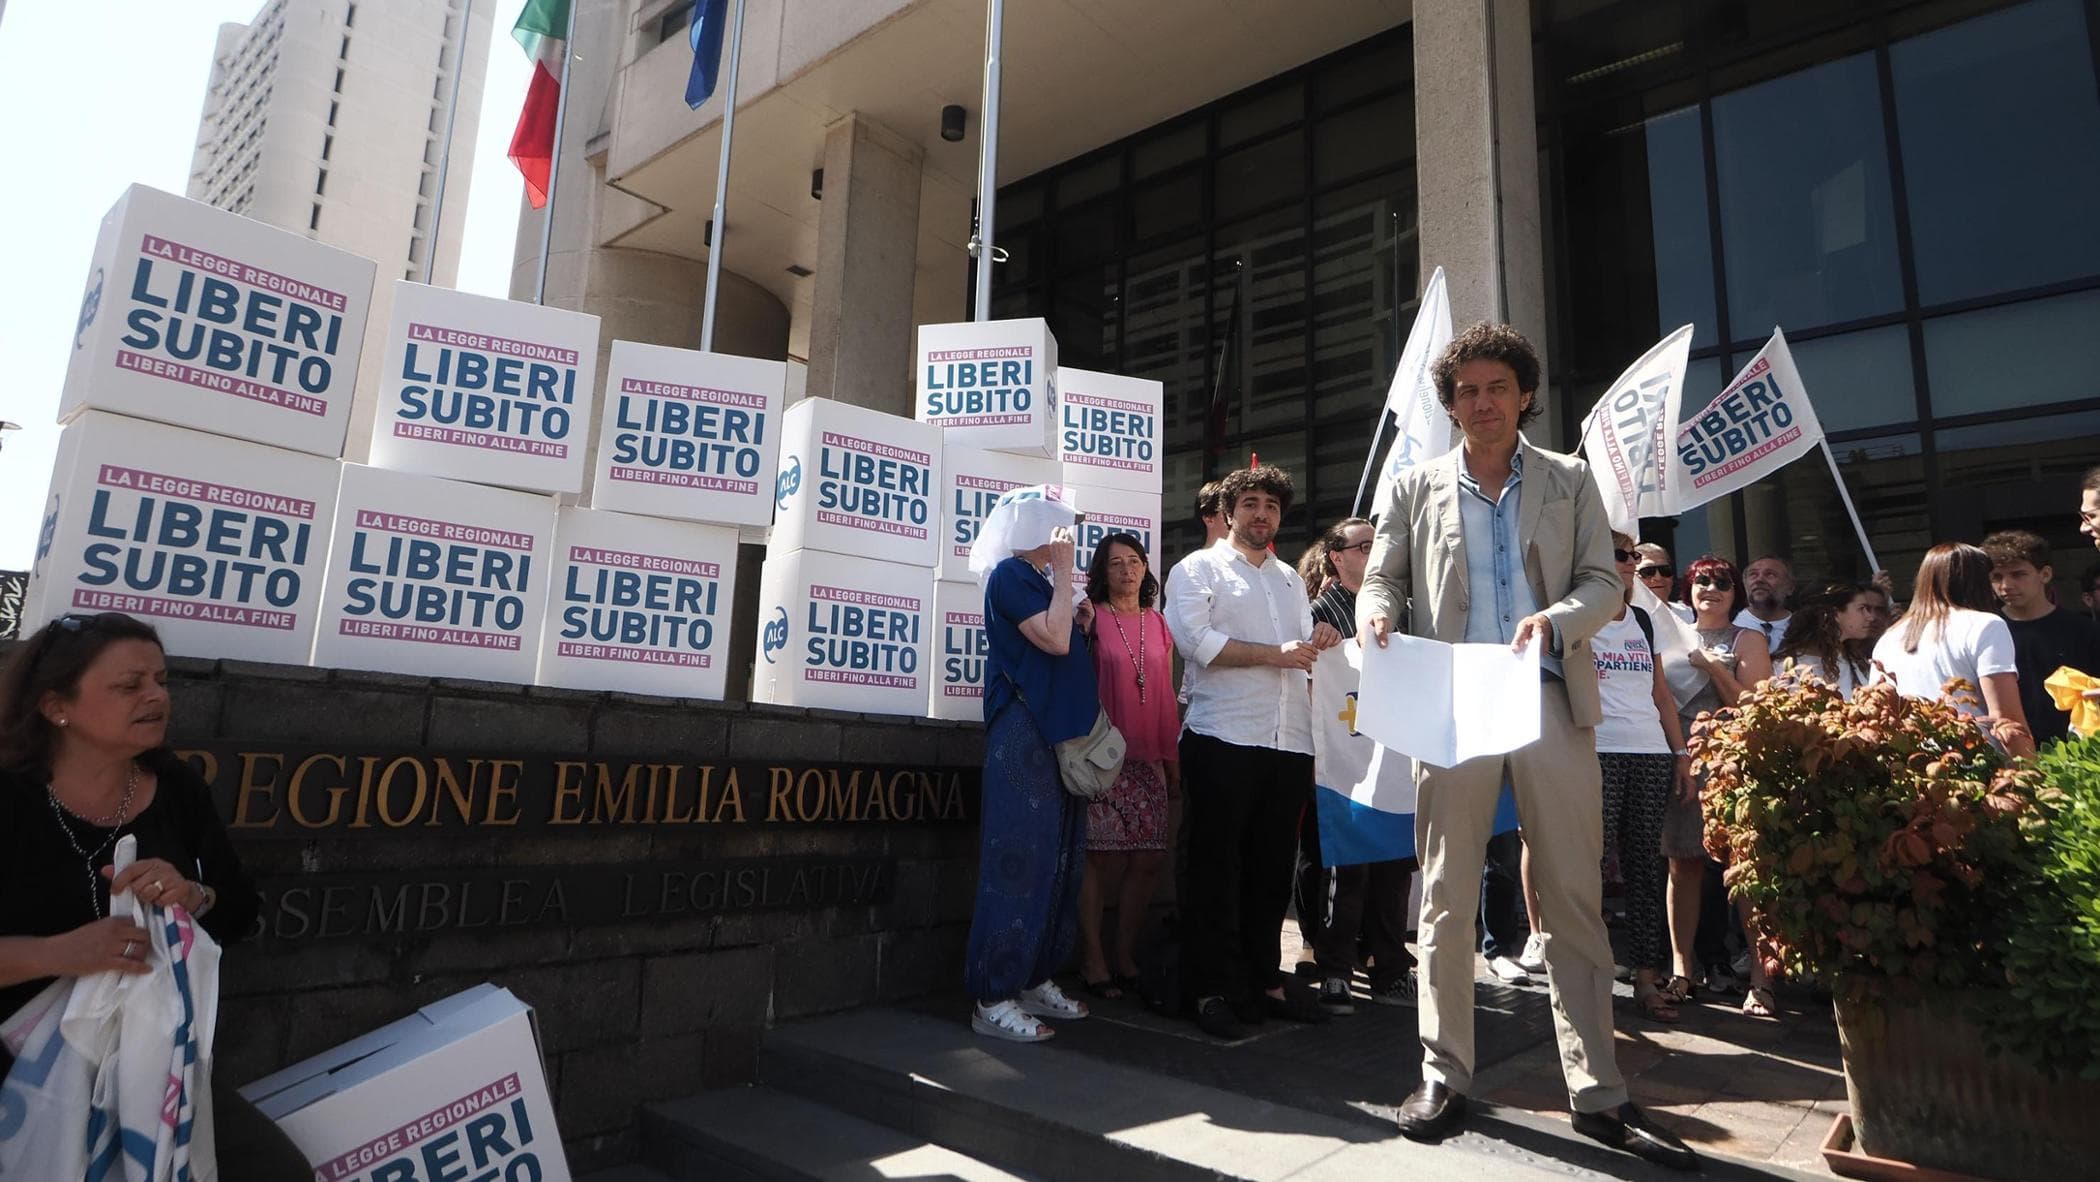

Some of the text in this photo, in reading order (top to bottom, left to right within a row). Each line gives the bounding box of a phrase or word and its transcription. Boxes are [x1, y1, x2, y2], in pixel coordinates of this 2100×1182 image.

[148, 238, 344, 309] LA LEGGE REGIONALE
[131, 256, 342, 355] LIBERI
[121, 311, 330, 392] SUBITO
[413, 326, 576, 363] LA LEGGE REGIONALE
[931, 348, 1030, 361] LA LEGGE REGIONALE
[121, 353, 322, 413] LIBERI FINO ALLA FINE
[402, 342, 576, 404] LIBERI
[928, 360, 1031, 389] LIBERI
[626, 380, 764, 407] LA LEGGE REGIONALE
[927, 388, 1030, 415] SUBITO
[1067, 394, 1151, 412] LA LEGGE REGIONALE
[396, 386, 569, 439] SUBITO
[617, 395, 764, 445] LIBERI
[960, 417, 981, 425] FINO
[983, 416, 1006, 424] ALLA
[1008, 415, 1029, 423] FINE
[1064, 404, 1152, 438] LIBERI
[397, 424, 564, 456] LIBERI FINO ALLA FINE
[612, 434, 759, 477] SUBITO
[826, 434, 928, 464] LA LEGGE REGIONALE
[1063, 431, 1152, 460] SUBITO
[1683, 402, 1793, 475] SUBITO
[1730, 456, 1751, 471] FINO
[1753, 443, 1776, 458] ALLA
[1777, 429, 1801, 447] FINE
[820, 447, 929, 496] LIBERI
[1065, 454, 1150, 471] LIBERI FINO ALLA FINE
[104, 468, 312, 516] LA LEGGE REGIONALE
[613, 469, 755, 493] LIBERI FINO ALLA FINE
[959, 477, 970, 486] LA
[973, 479, 1001, 490] LEGGE
[818, 482, 927, 524] SUBITO
[87, 488, 311, 565] LIBERI
[362, 513, 530, 549] LA LEGGE REGIONALE
[820, 512, 924, 538] LIBERI FINO ALLA FINE
[1104, 515, 1149, 528] REGIONALE
[77, 544, 299, 607] SUBITO
[349, 531, 530, 592] LIBERI
[574, 548, 717, 576] LA LEGGE REGIONALE
[342, 579, 523, 630] SUBITO
[565, 565, 717, 615] LIBERI
[814, 587, 918, 610] LA LEGGE REGIONALE
[78, 591, 291, 628] LIBERI FINO ALLA FINE
[808, 601, 919, 644] LIBERI
[949, 614, 960, 624] LA
[344, 621, 517, 648] LIBERI FINO ALLA FINE
[560, 606, 712, 650] SUBITO
[561, 644, 707, 666] LIBERI FINO ALLA FINE
[806, 637, 916, 674] SUBITO
[1603, 652, 1625, 661] MIA
[807, 670, 913, 687] LIBERI FINO ALLA FINE
[947, 687, 975, 696] LIBERI
[333, 1133, 401, 1178] LEGGE
[405, 1074, 519, 1140] REGIONALE
